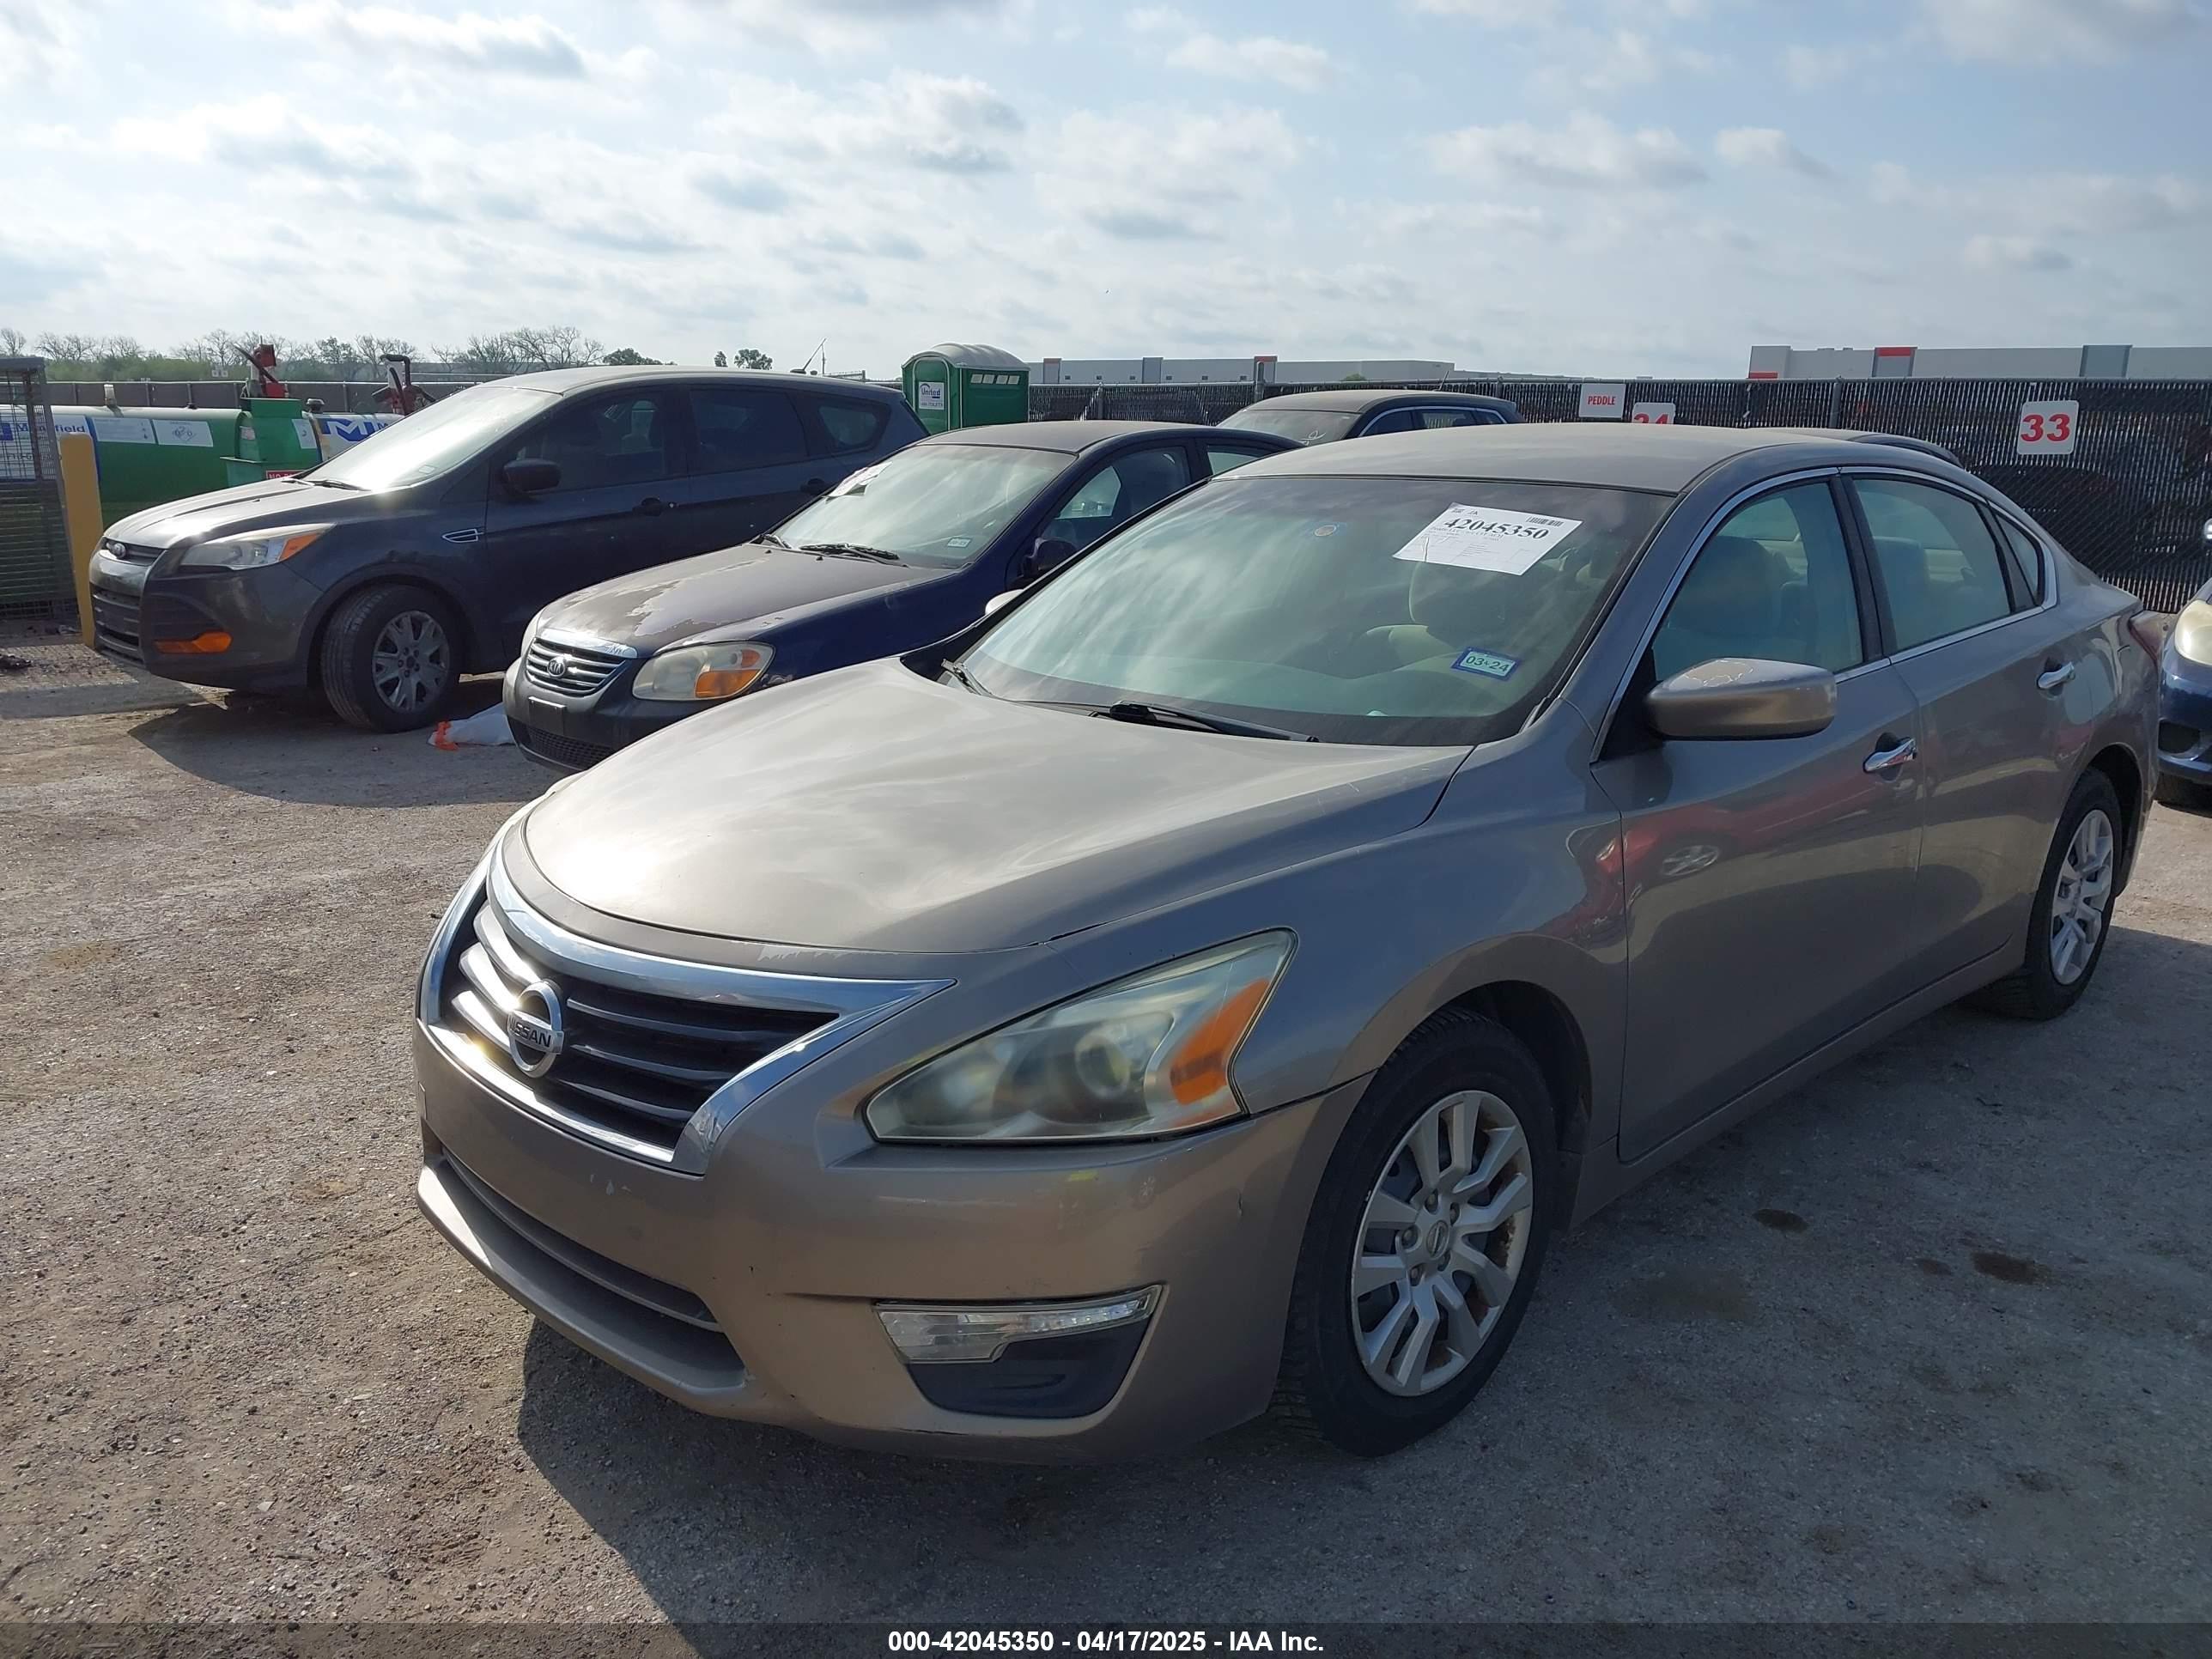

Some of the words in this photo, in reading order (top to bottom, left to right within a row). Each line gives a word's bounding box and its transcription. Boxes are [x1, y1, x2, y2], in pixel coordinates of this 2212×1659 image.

[921, 387, 940, 396] United
[1587, 396, 1616, 405] PEDDLE
[2021, 414, 2070, 442] 33
[1444, 517, 1549, 539] 42045350
[550, 661, 562, 674] KIA
